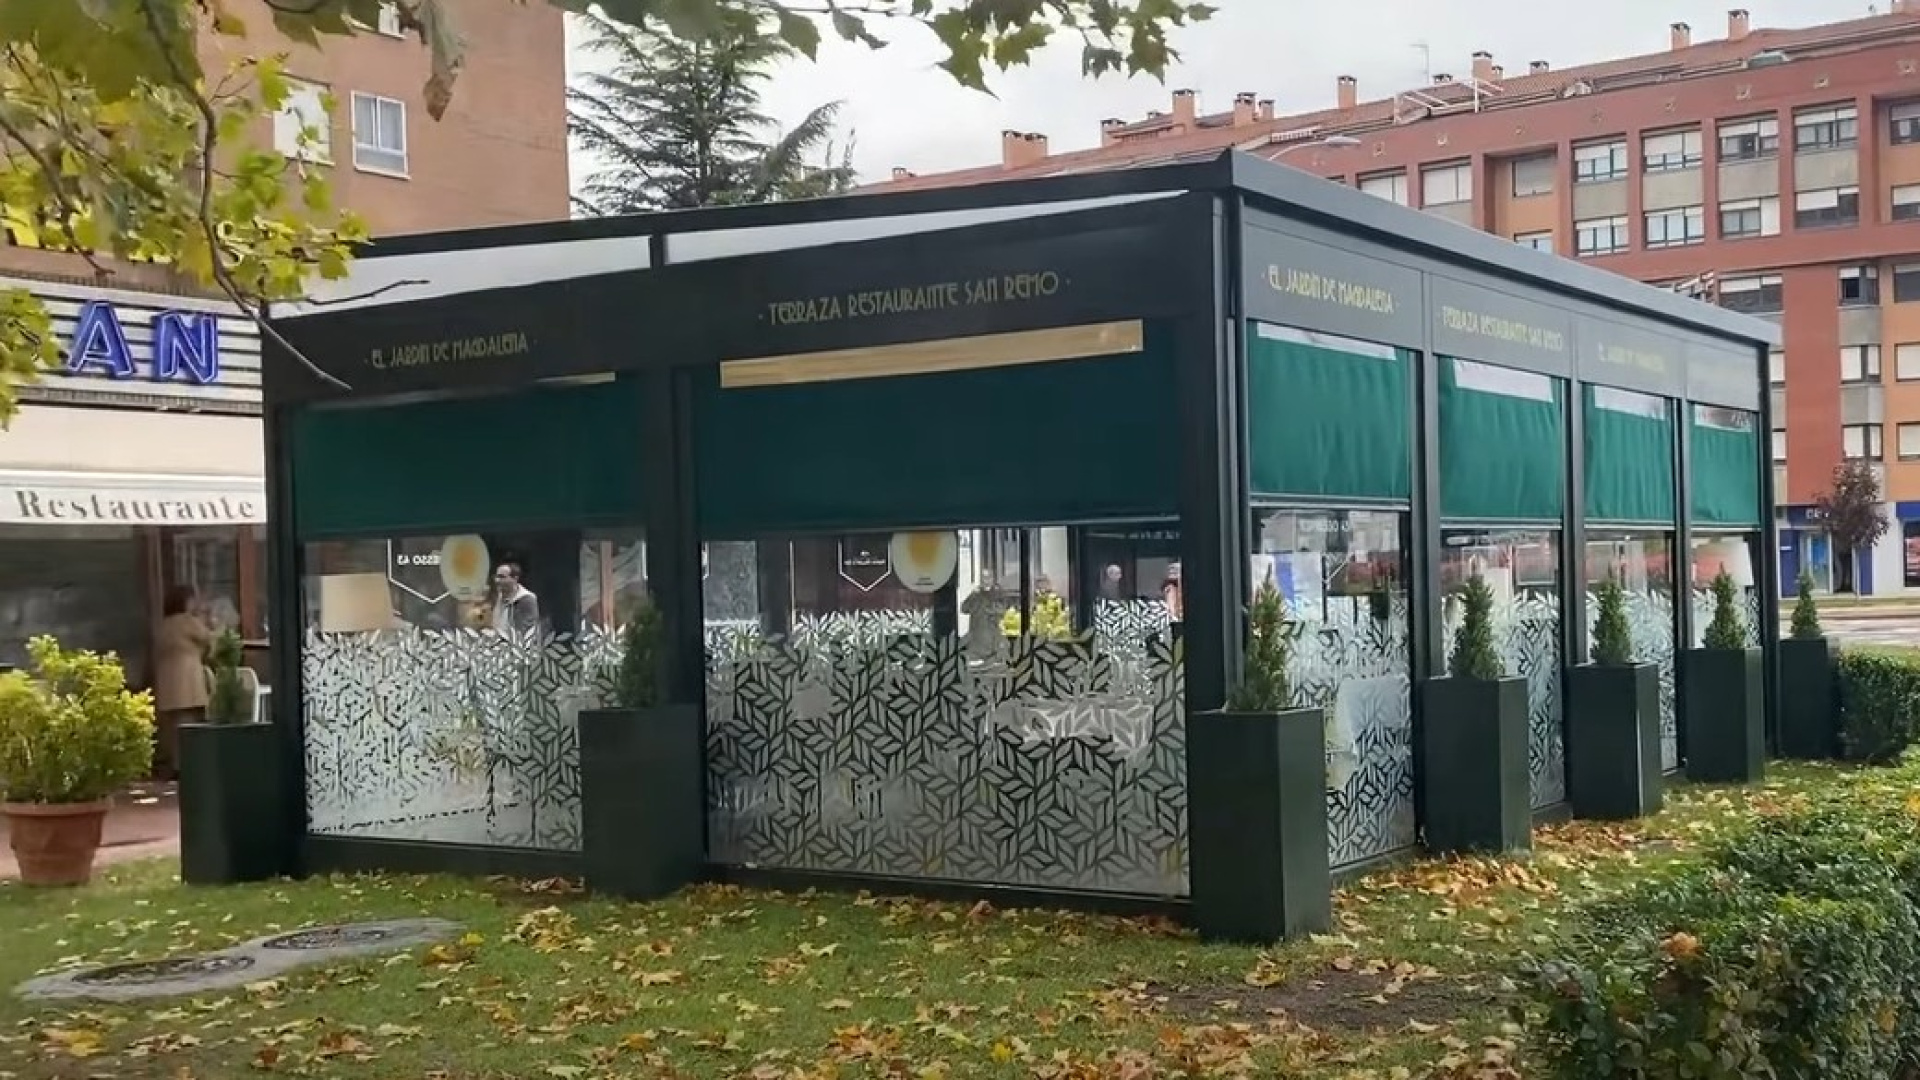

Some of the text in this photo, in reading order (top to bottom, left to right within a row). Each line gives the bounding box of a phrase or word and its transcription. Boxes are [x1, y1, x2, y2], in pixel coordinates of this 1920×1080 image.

[768, 270, 1059, 326] TERRAZA RESTAURANTE SAN REMO
[15, 490, 256, 519] Restaurante
